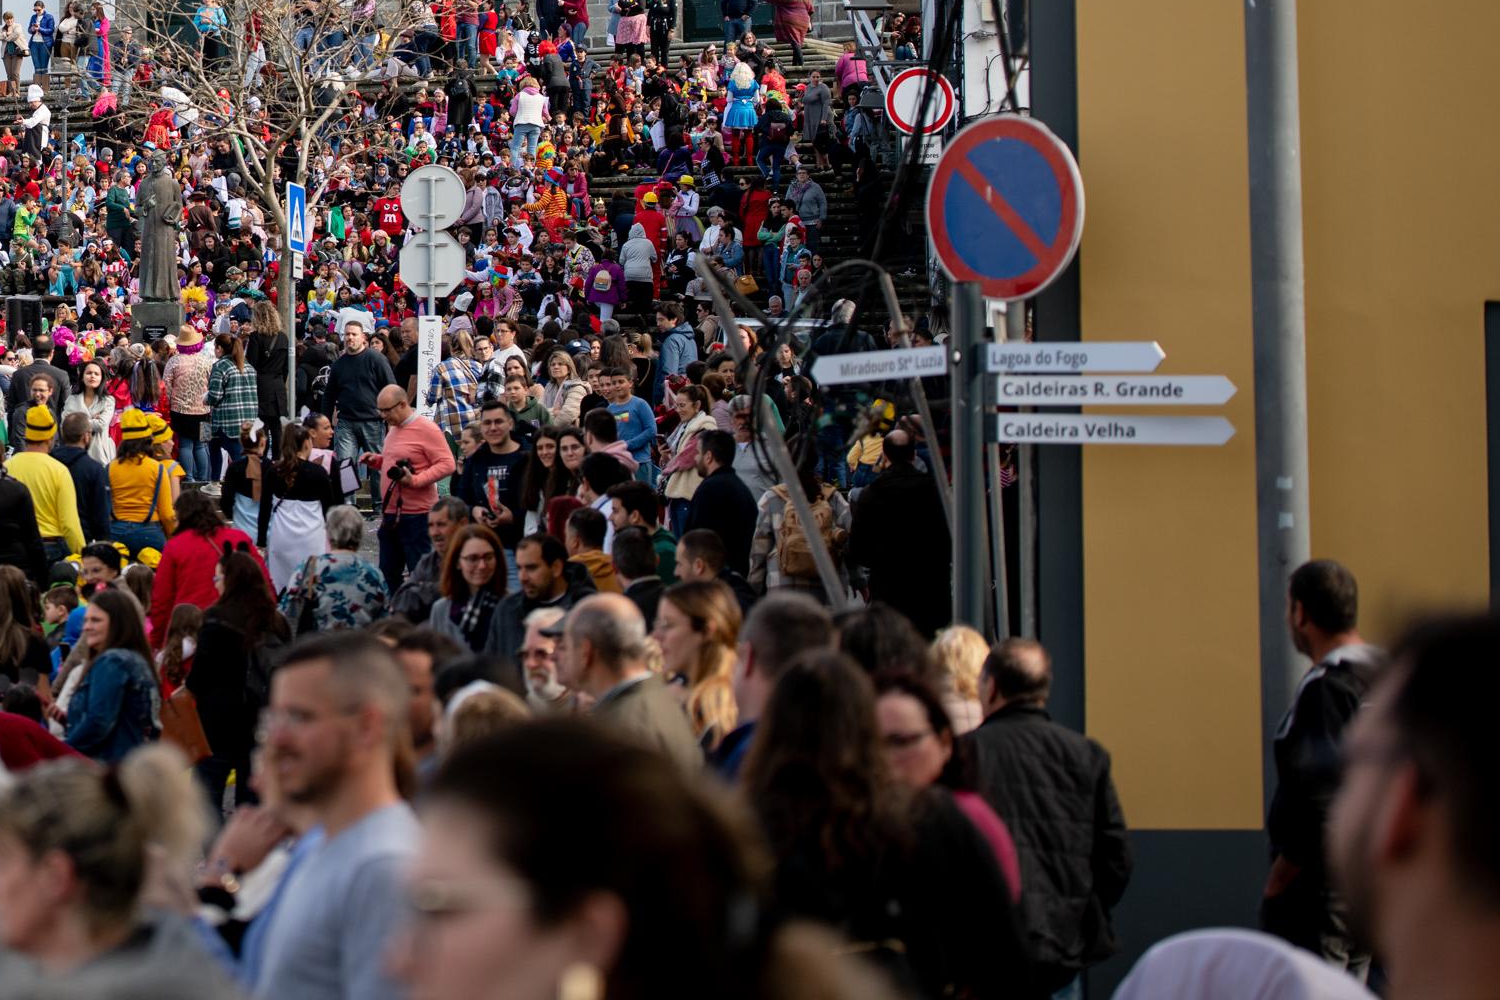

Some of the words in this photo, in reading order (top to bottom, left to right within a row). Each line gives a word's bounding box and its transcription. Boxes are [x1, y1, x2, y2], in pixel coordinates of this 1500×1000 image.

[383, 213, 397, 223] m
[840, 360, 896, 377] Miradouro
[915, 353, 944, 370] Luzia
[992, 350, 1031, 368] Lagoa
[1035, 350, 1052, 366] do
[1056, 351, 1088, 368] Fogo
[1002, 381, 1088, 397] Caldeiras
[1094, 382, 1110, 397] R.
[1116, 382, 1184, 398] Grande
[1003, 422, 1079, 438] Caldeira
[1084, 422, 1136, 439] Velha
